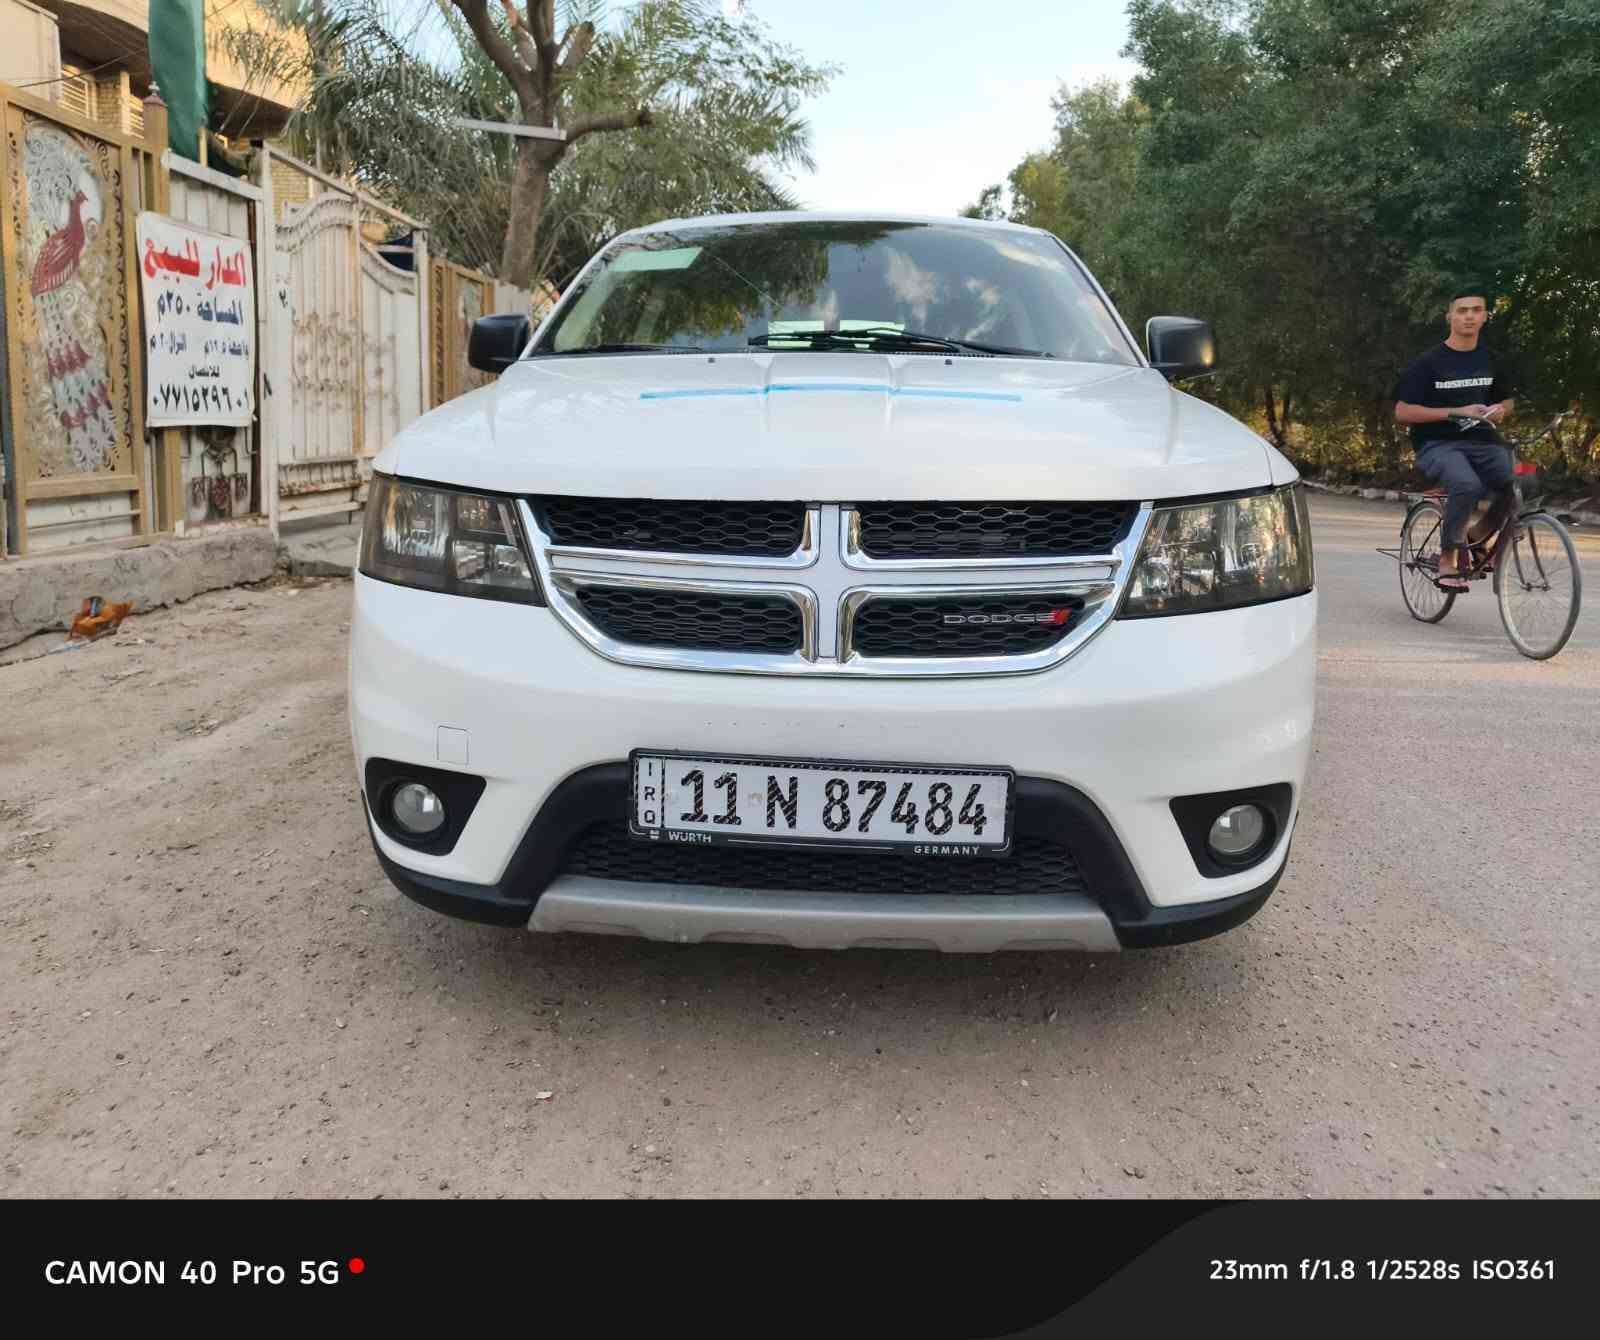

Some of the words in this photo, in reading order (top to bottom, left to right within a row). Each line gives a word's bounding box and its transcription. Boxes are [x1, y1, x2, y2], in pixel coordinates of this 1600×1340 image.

[144, 238, 200, 283] للبيع
[206, 245, 246, 289] الدار
[197, 292, 244, 325] المساحة
[943, 612, 1056, 624] DODGE
[680, 769, 742, 826] 11
[766, 775, 798, 830] N
[822, 778, 987, 836] 87484
[913, 845, 980, 855] GERMANY
